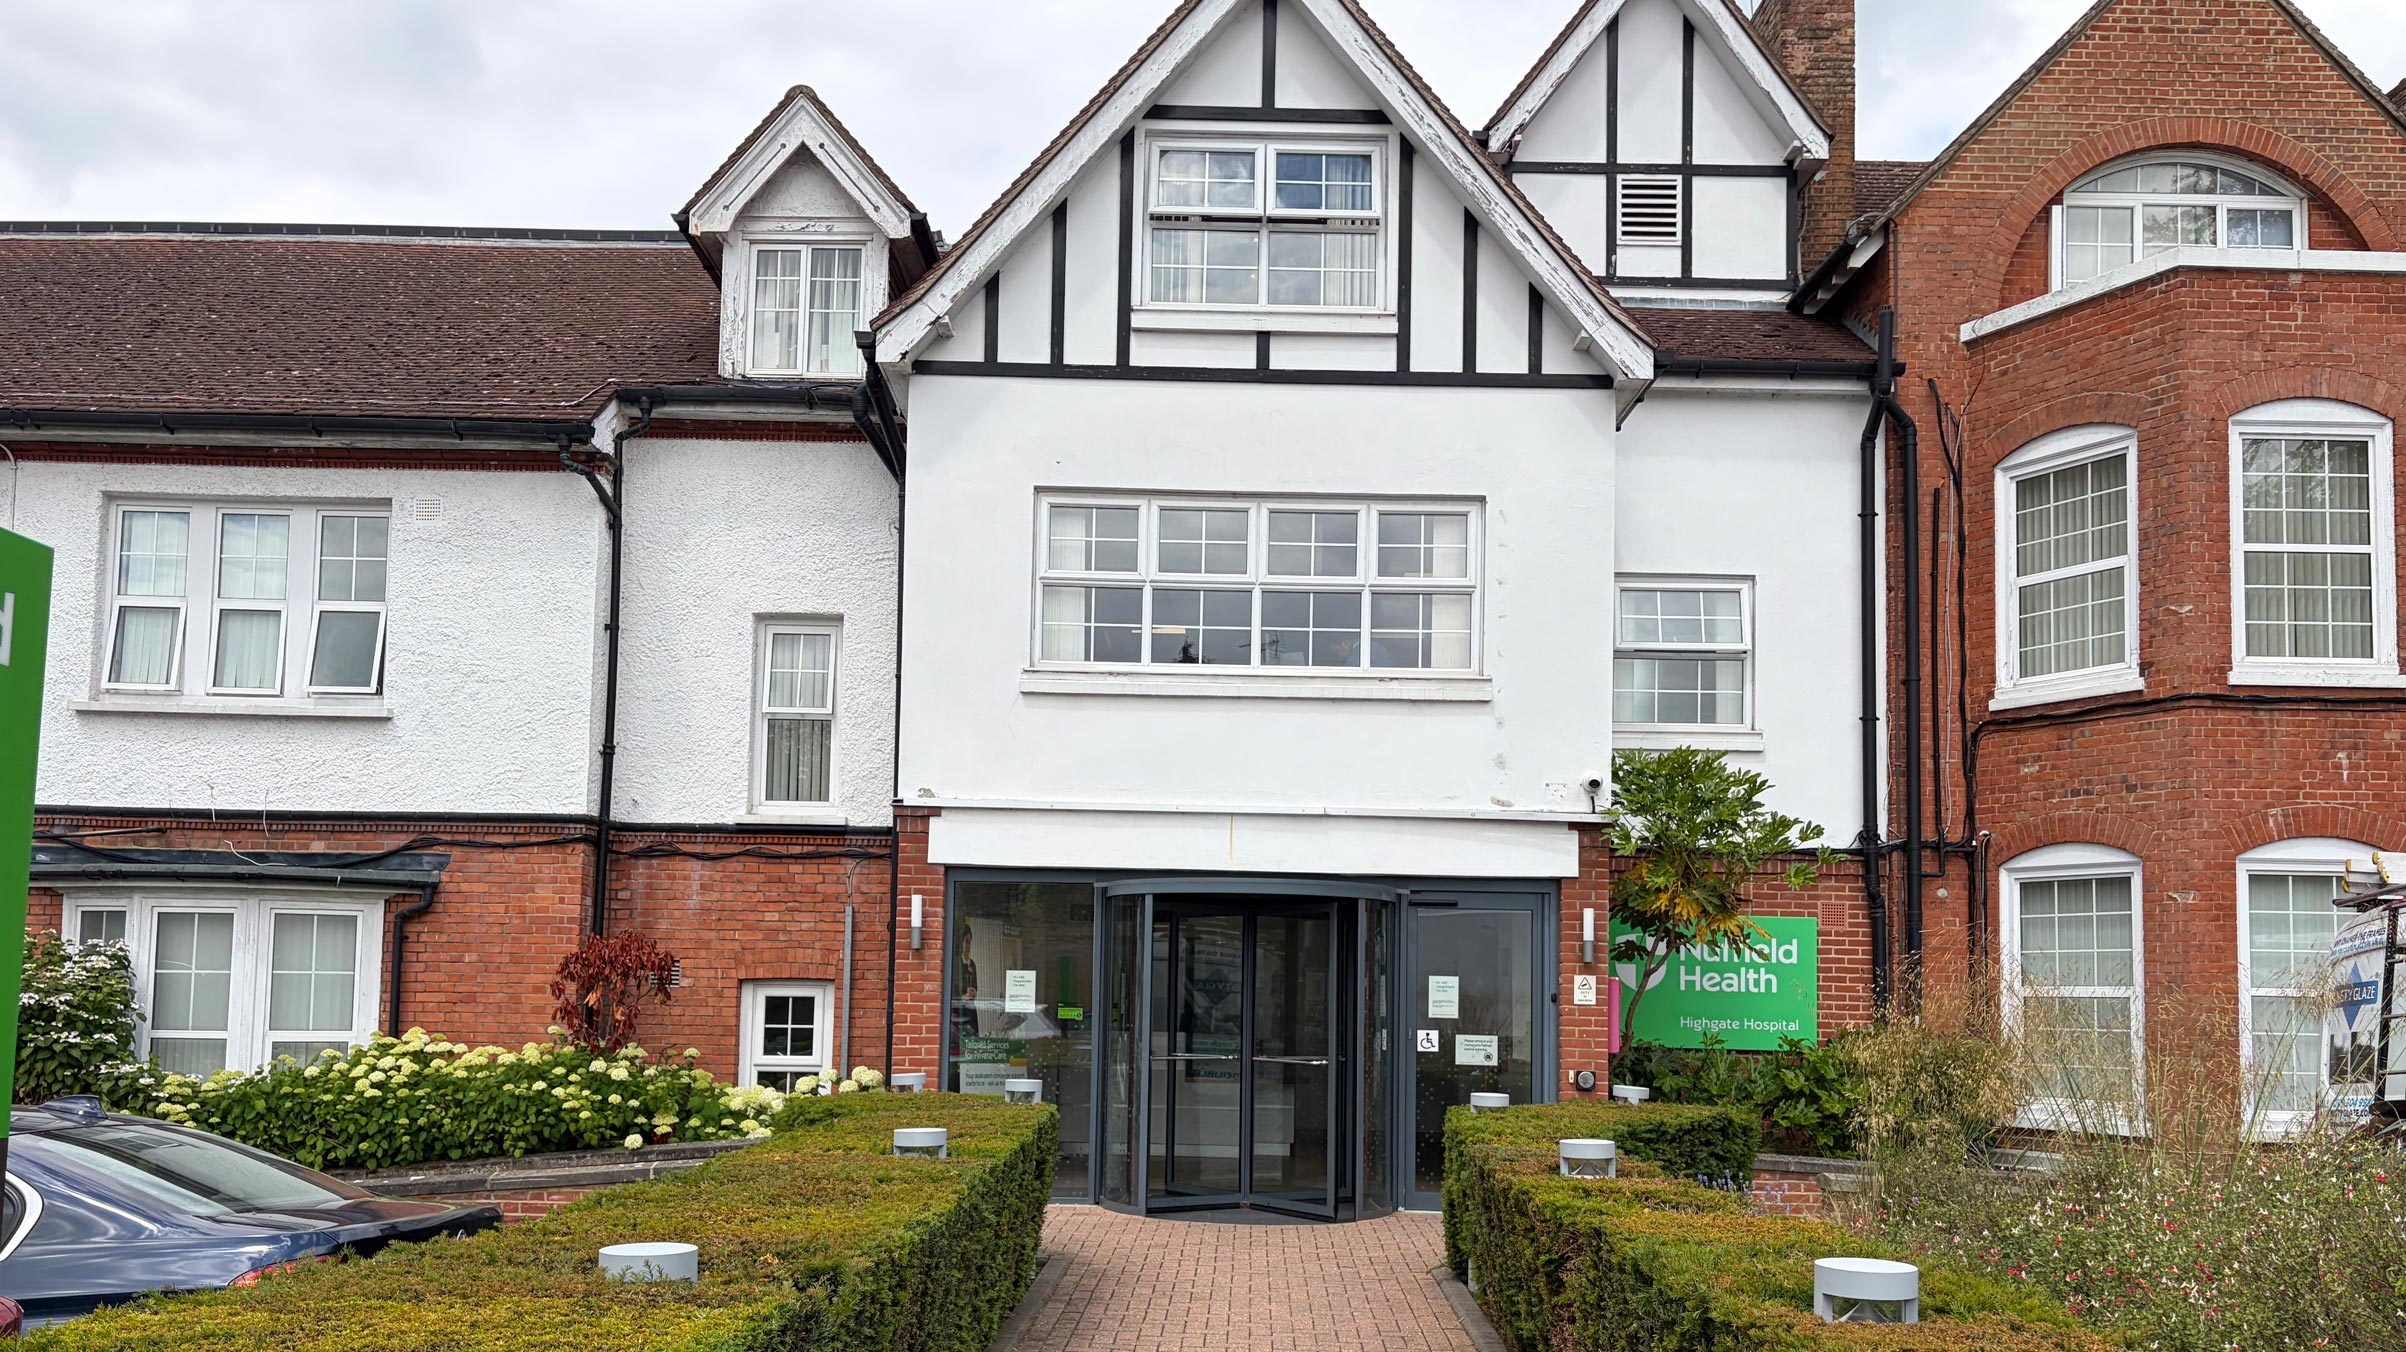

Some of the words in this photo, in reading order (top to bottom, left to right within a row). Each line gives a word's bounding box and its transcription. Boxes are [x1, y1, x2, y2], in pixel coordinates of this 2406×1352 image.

[1680, 965, 1778, 993] Health
[2353, 986, 2376, 1001] GLAZE
[1680, 1016, 1740, 1032] Highgate
[1744, 1018, 1799, 1033] Hospital
[965, 1040, 987, 1049] Tailored
[987, 1040, 1009, 1049] Services
